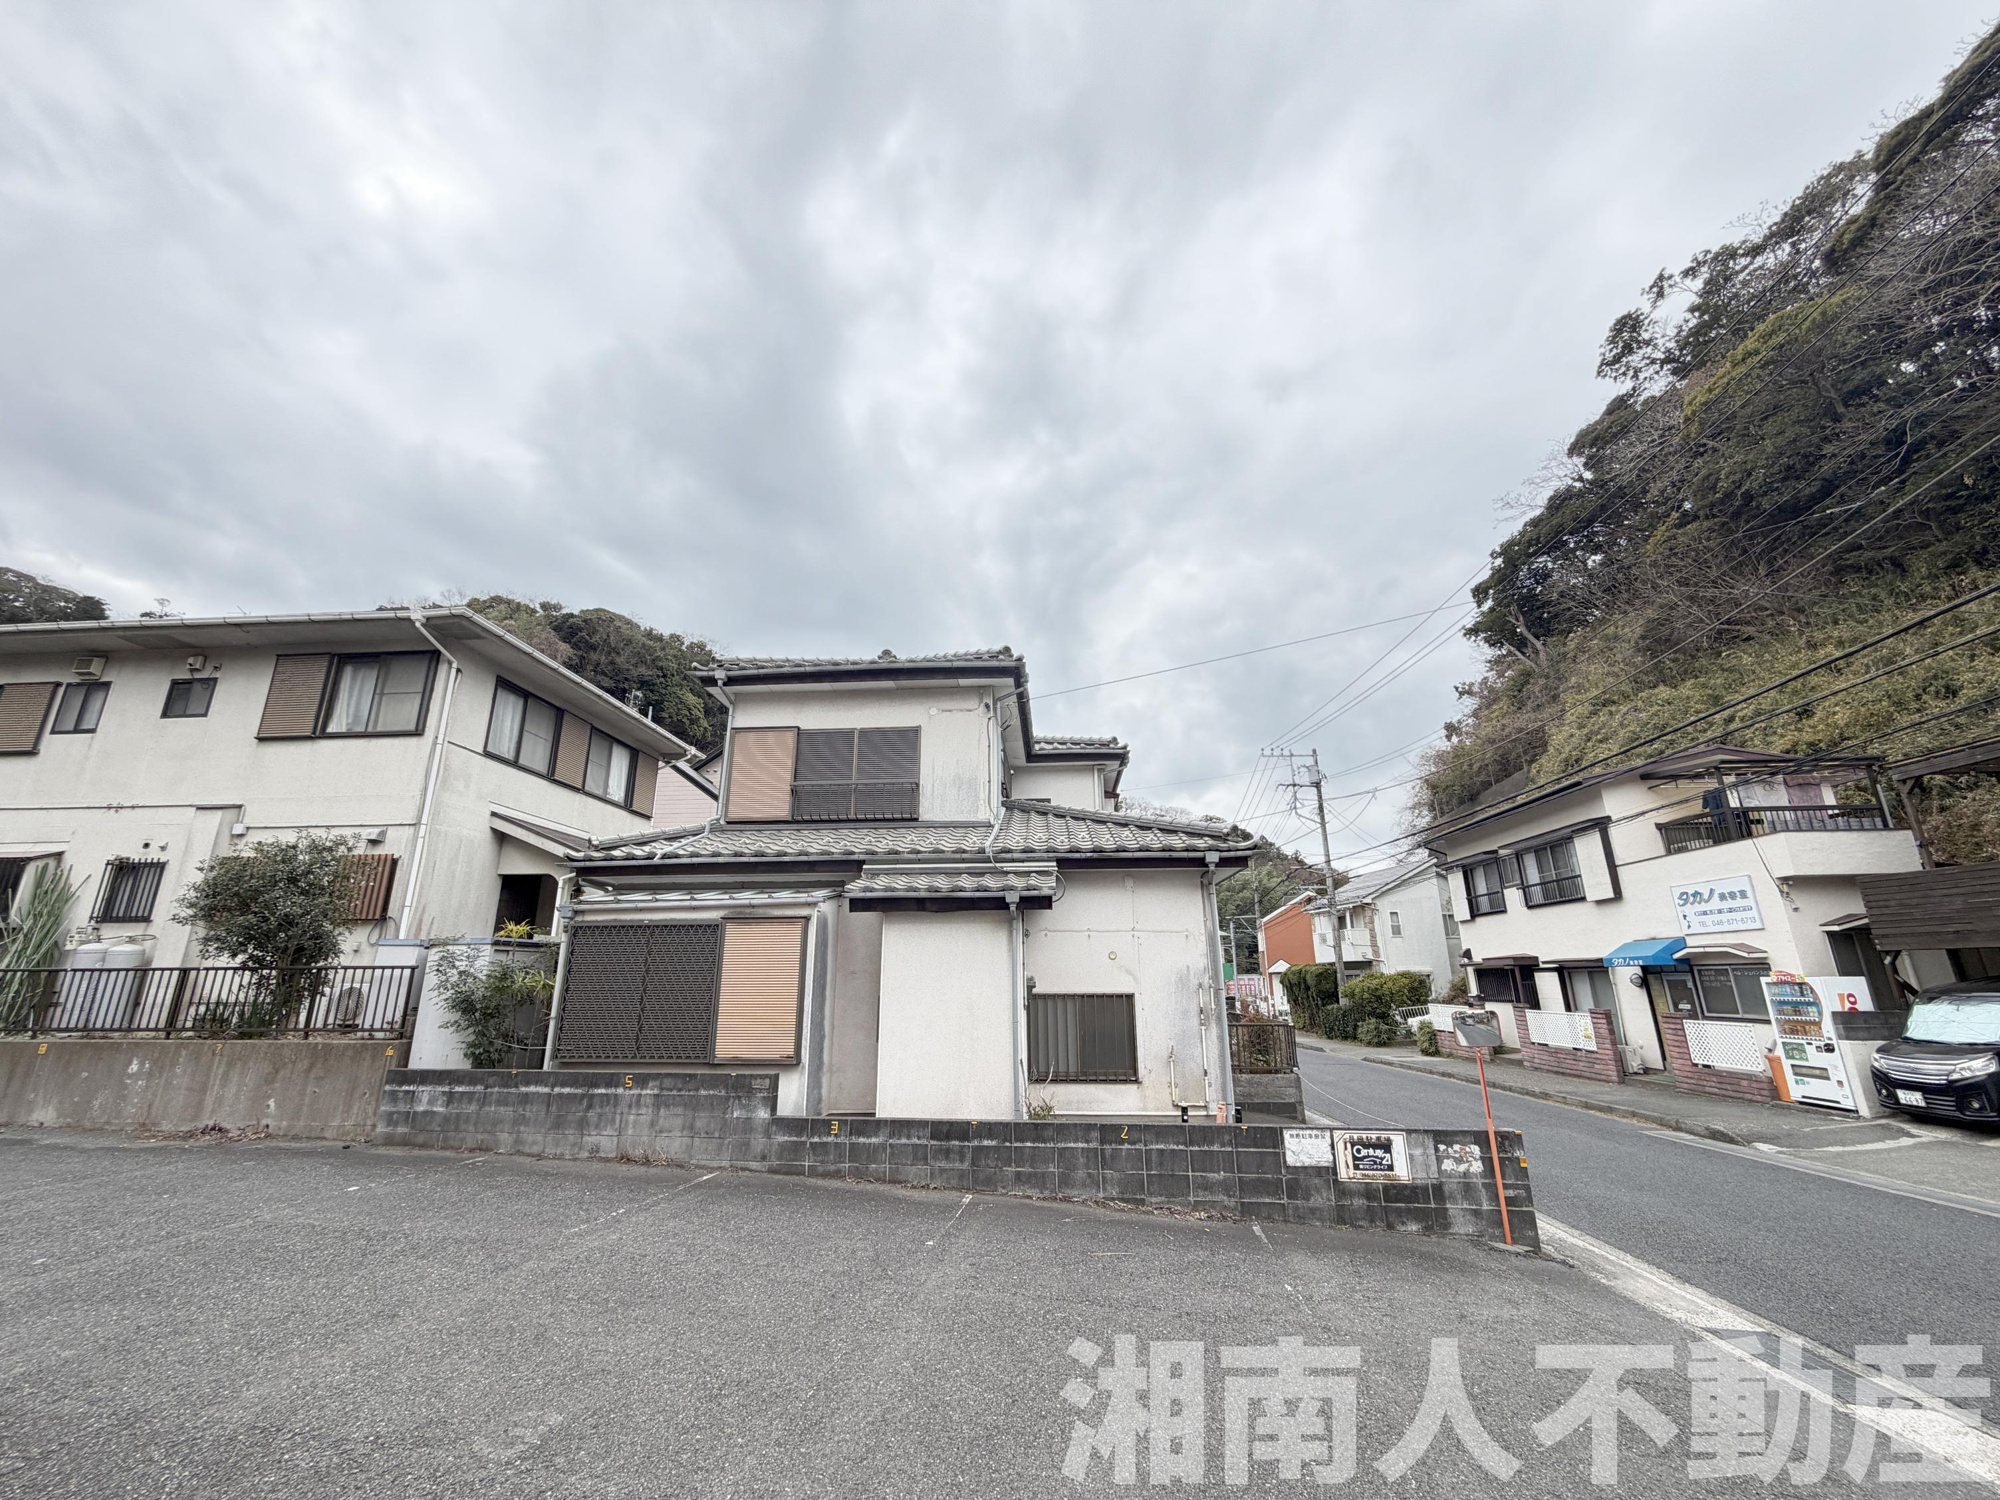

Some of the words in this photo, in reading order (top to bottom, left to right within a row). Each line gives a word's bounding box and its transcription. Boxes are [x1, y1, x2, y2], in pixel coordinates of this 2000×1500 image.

[1677, 887, 1715, 907] タカノ
[1717, 889, 1750, 902] 美容室
[1611, 957, 1630, 967] タカノ
[625, 1075, 633, 1087] 5
[830, 1121, 839, 1134] 3
[1120, 1125, 1129, 1139] 2
[1353, 1145, 1384, 1158] Century
[1381, 1153, 1392, 1165] 21
